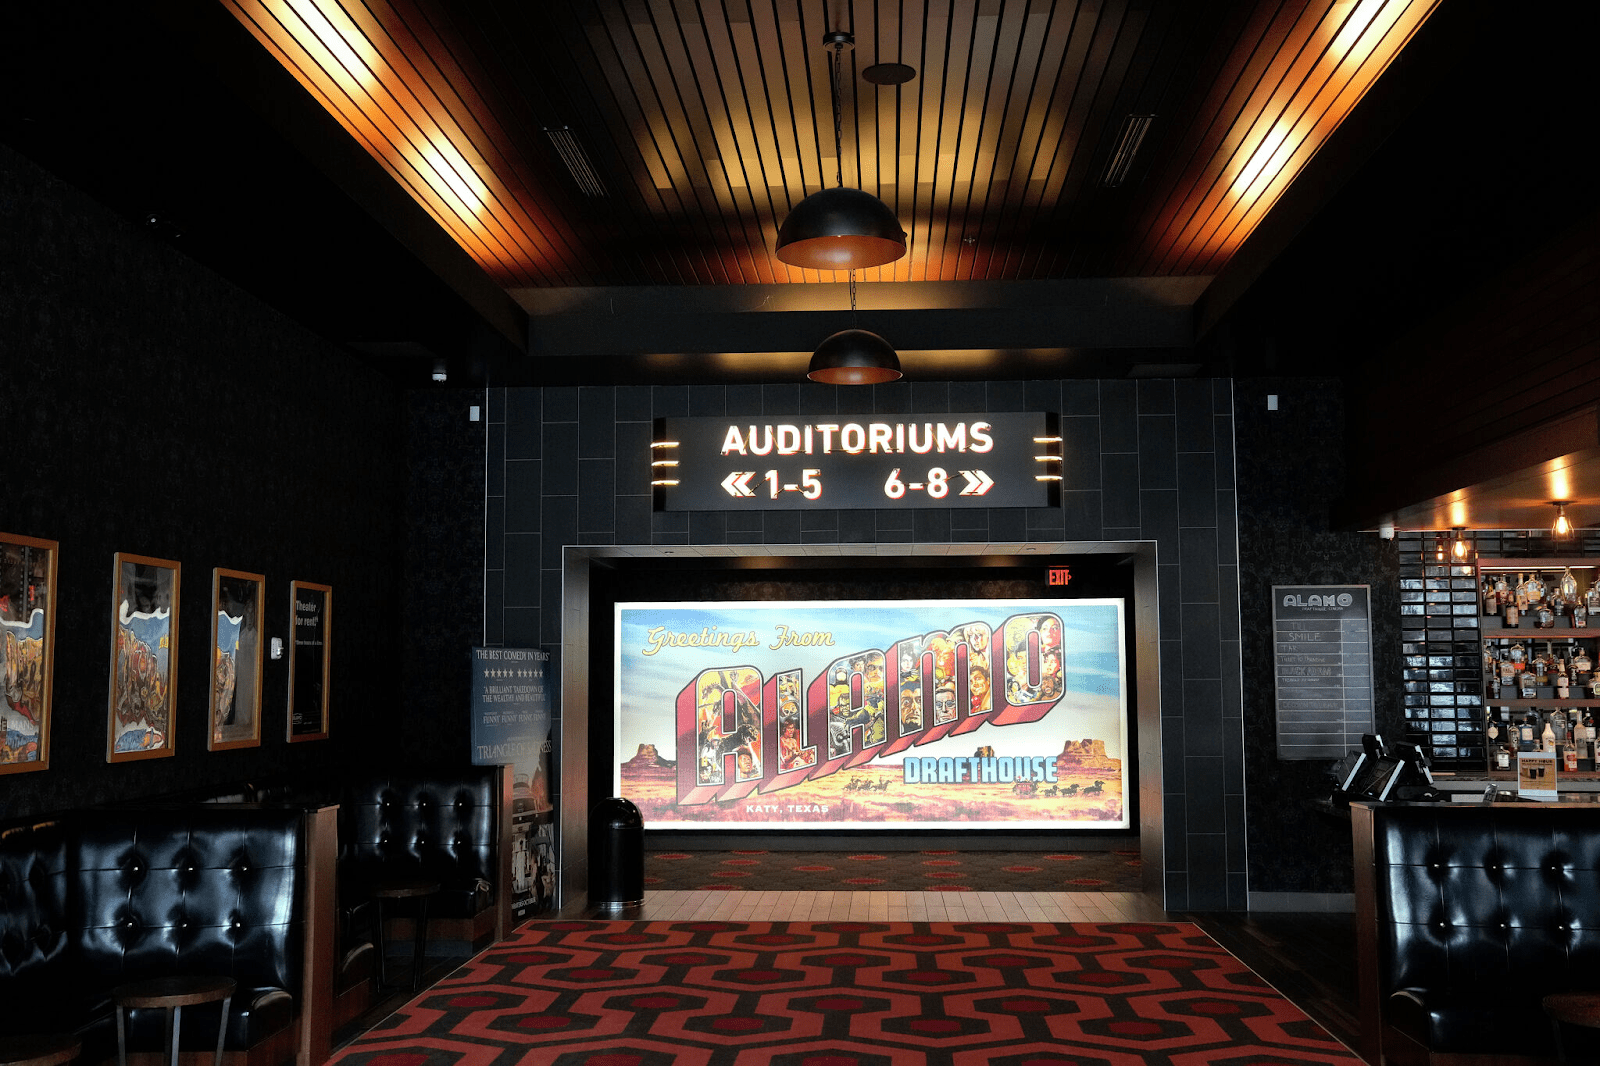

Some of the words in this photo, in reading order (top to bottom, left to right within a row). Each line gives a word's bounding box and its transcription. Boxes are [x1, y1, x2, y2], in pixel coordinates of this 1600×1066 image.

[720, 422, 994, 456] AUDITORIUMS
[765, 468, 822, 499] 1-5
[884, 467, 949, 499] 6-8
[1049, 569, 1070, 586] EXIT
[295, 600, 317, 612] Theater
[1283, 593, 1353, 607] ALAMO
[295, 615, 303, 626] for
[642, 625, 760, 656] Greetings
[769, 624, 836, 651] From
[1288, 632, 1321, 642] SMILE
[489, 650, 503, 660] BEST
[503, 651, 527, 661] COMEDY
[527, 651, 534, 661] IN
[482, 694, 493, 703] THE
[677, 611, 1067, 806] ALAMO
[476, 742, 515, 760] TRIANGLE
[903, 756, 1059, 785] DRAFTHOUSE
[746, 805, 783, 814] KATY,
[787, 804, 829, 813] TEXAS
